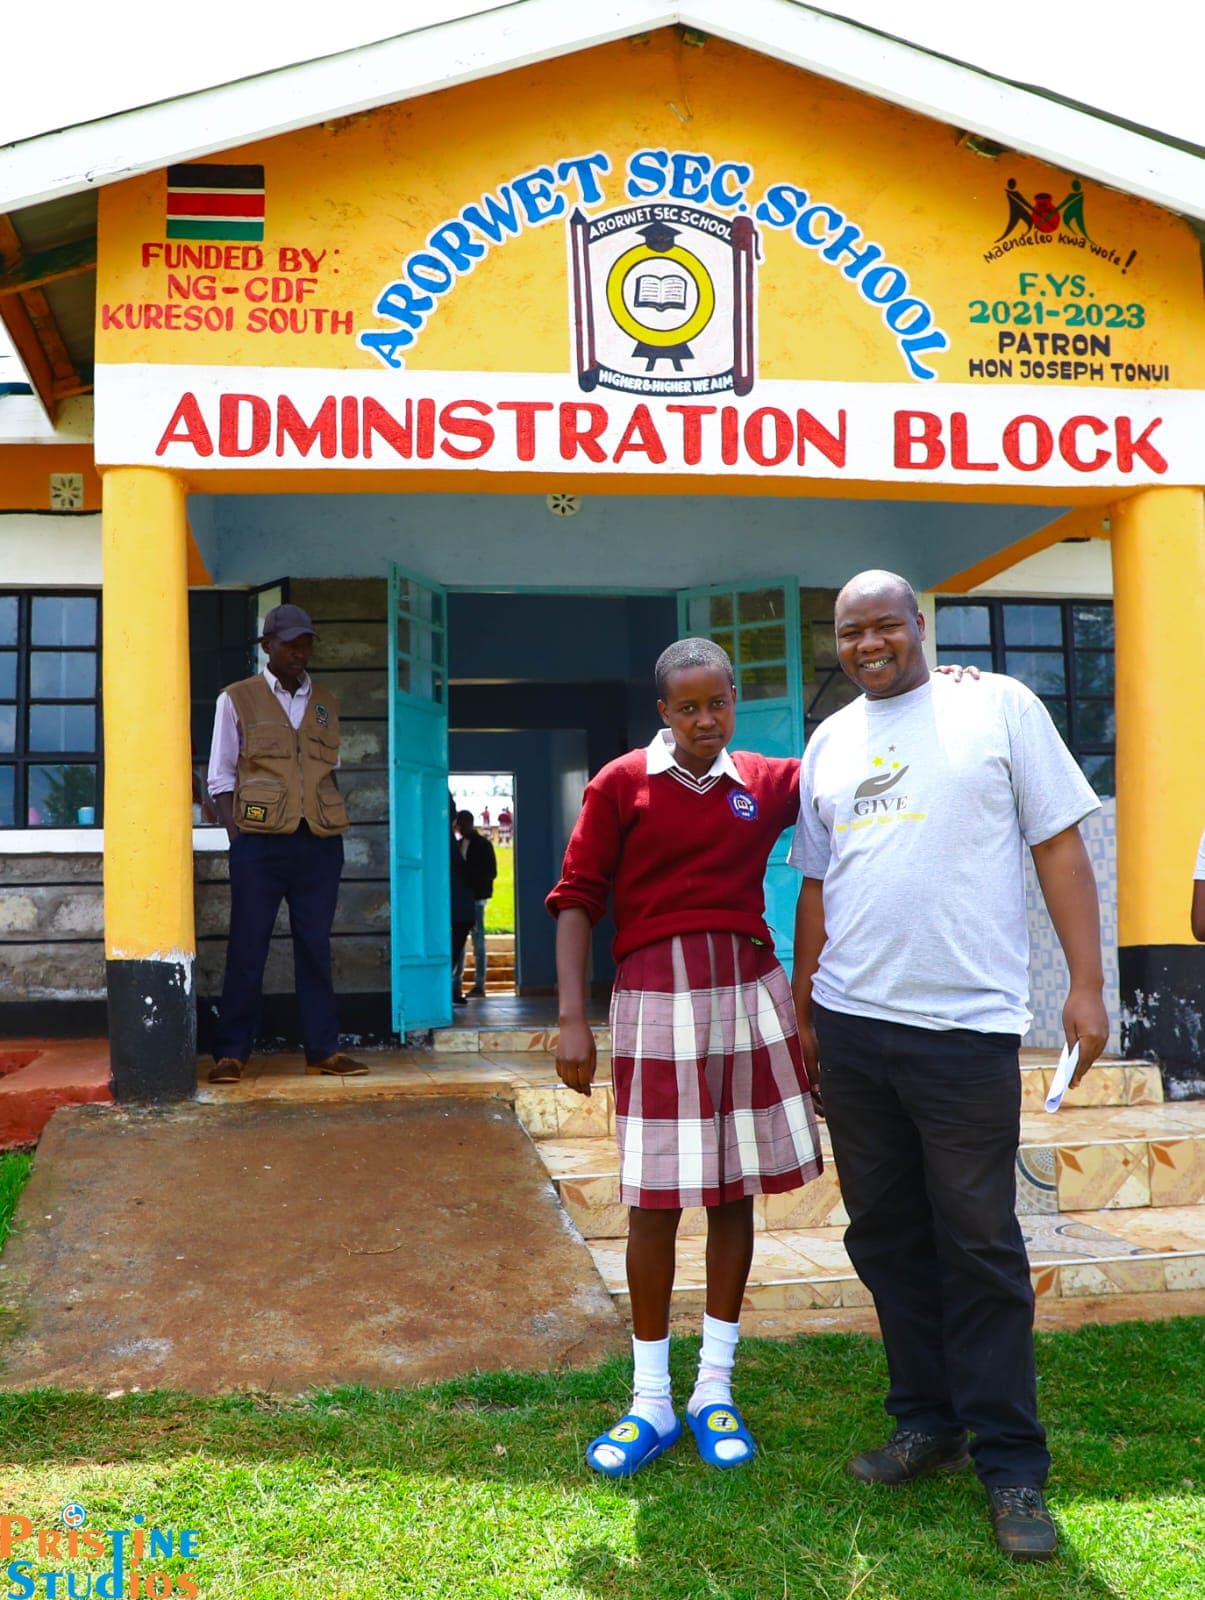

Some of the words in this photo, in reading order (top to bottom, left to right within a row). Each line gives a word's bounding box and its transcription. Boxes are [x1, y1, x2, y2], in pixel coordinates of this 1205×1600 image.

[589, 207, 651, 239] ARORWET
[653, 206, 679, 220] SEC
[680, 209, 733, 240] SCHOOL
[1058, 232, 1087, 249] kwa
[141, 242, 264, 271] FUNDED
[360, 152, 609, 369] ARORWET
[627, 150, 750, 212] SEC.
[756, 184, 946, 380] SCHOOL
[167, 274, 319, 304] NG-CDF
[102, 303, 234, 332] KURESOI
[246, 306, 354, 336] SOUTH
[968, 300, 1145, 329] 2021-2023
[998, 331, 1111, 357] PATRON
[969, 358, 1012, 378] HON
[1020, 361, 1104, 381] JOSEPH
[1110, 363, 1169, 382] TONUI
[692, 378, 710, 393] WE
[155, 391, 847, 467] ADMINISTRATION
[894, 409, 1168, 475] BLOCK
[853, 796, 908, 816] GIVE
